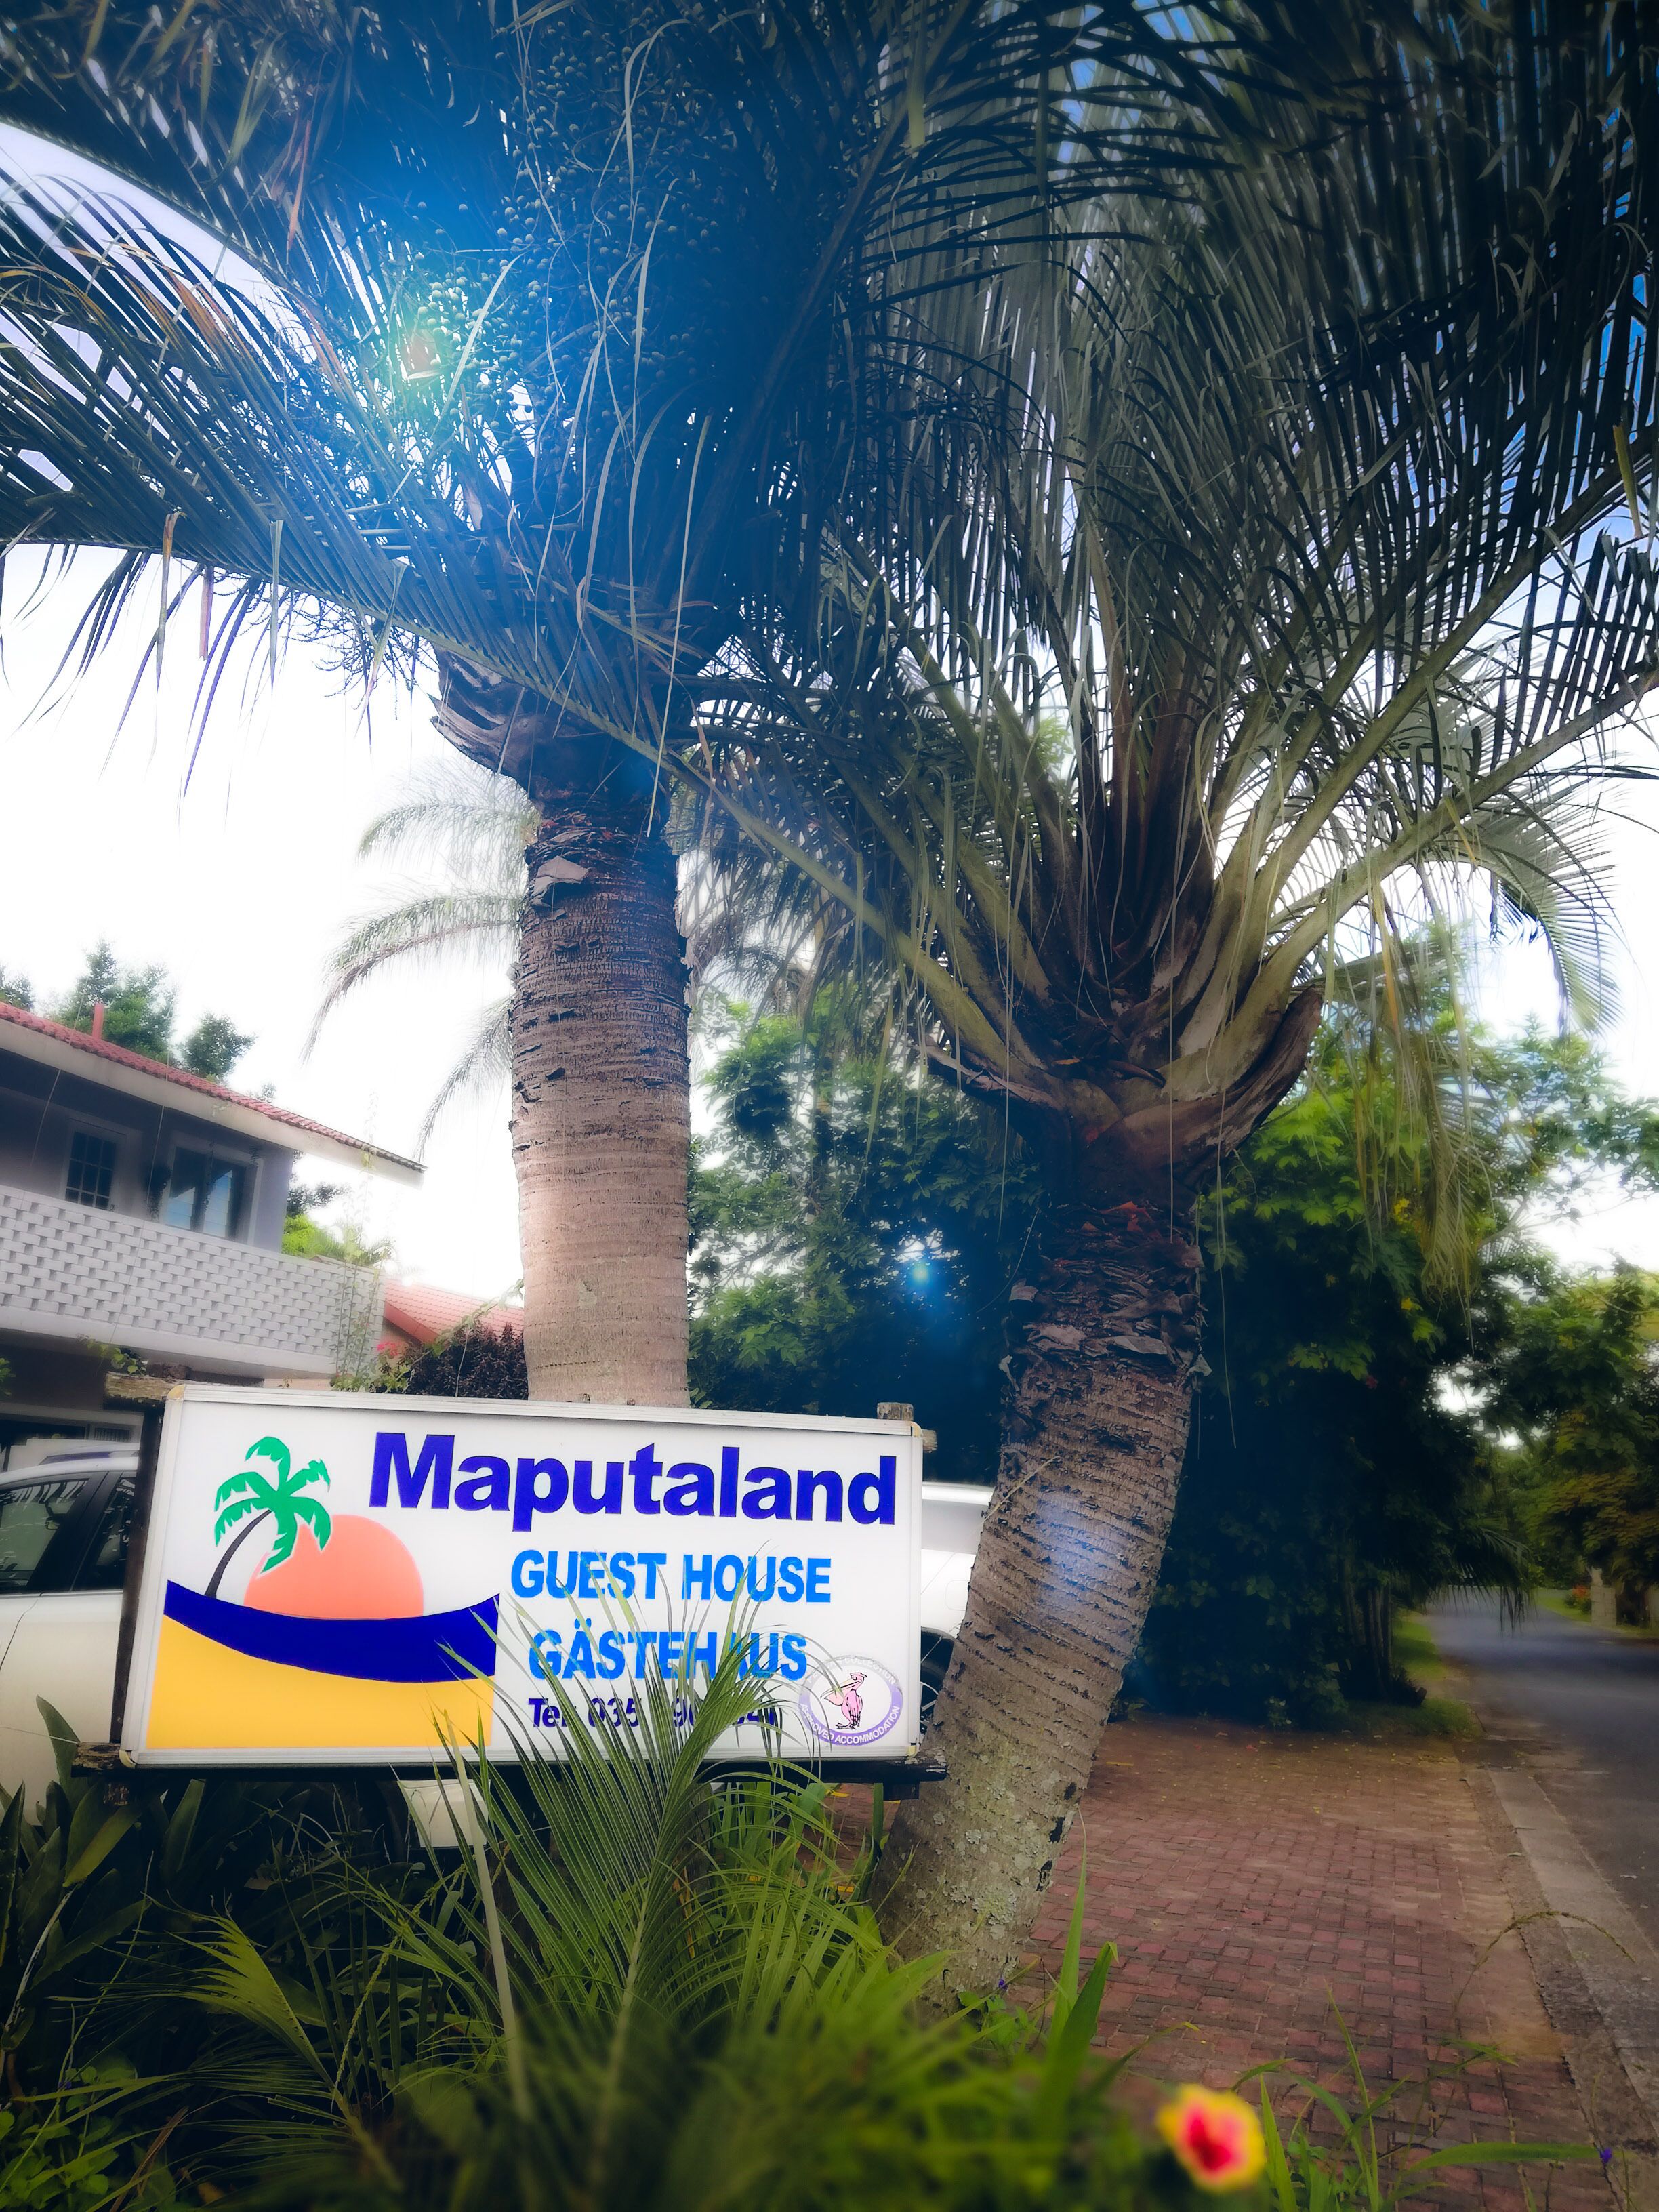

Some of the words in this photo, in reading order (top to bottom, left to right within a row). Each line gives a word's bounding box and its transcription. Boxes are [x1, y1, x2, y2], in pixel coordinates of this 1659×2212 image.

[369, 1431, 897, 1532] Maputaland
[511, 1549, 667, 1600] GUEST
[681, 1553, 832, 1603] HOUSE
[834, 1706, 901, 1744] ACCOMMODATION
